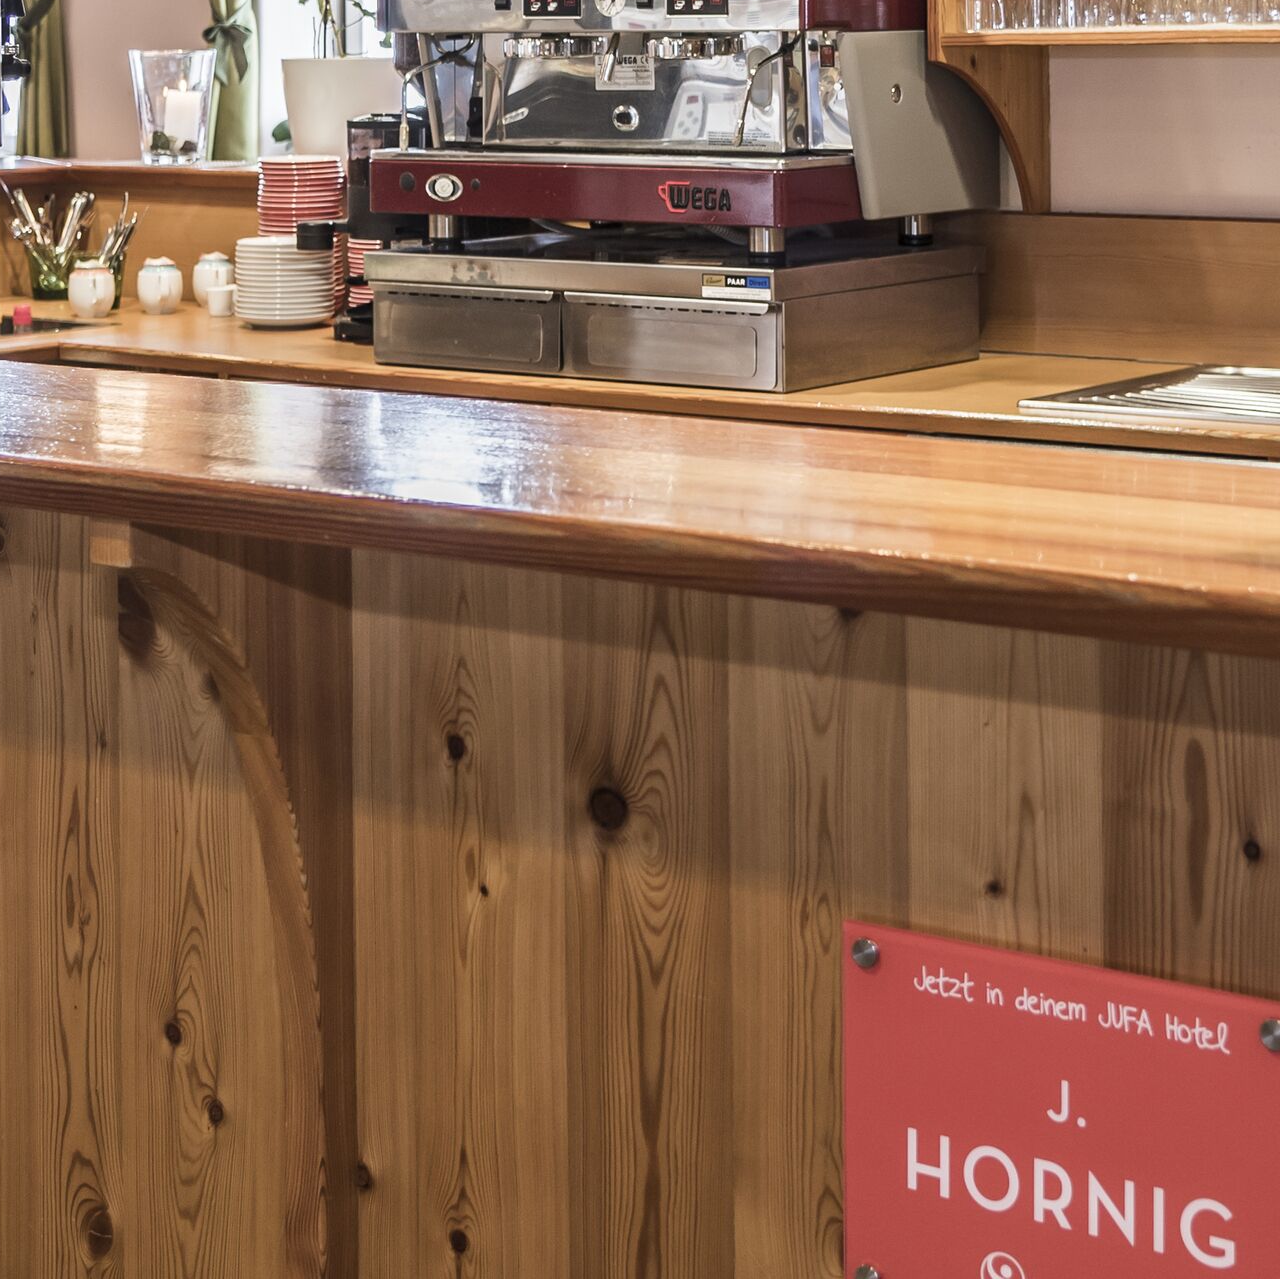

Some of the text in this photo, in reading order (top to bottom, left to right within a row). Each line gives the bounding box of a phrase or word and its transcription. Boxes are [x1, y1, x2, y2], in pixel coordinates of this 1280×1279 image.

[669, 186, 732, 212] WEGA
[726, 277, 746, 287] PAAR
[912, 964, 1231, 1055] Jetzt in deinem JUFA Hotel
[1046, 1079, 1087, 1128] J.
[906, 1126, 1237, 1269] HORNIG
